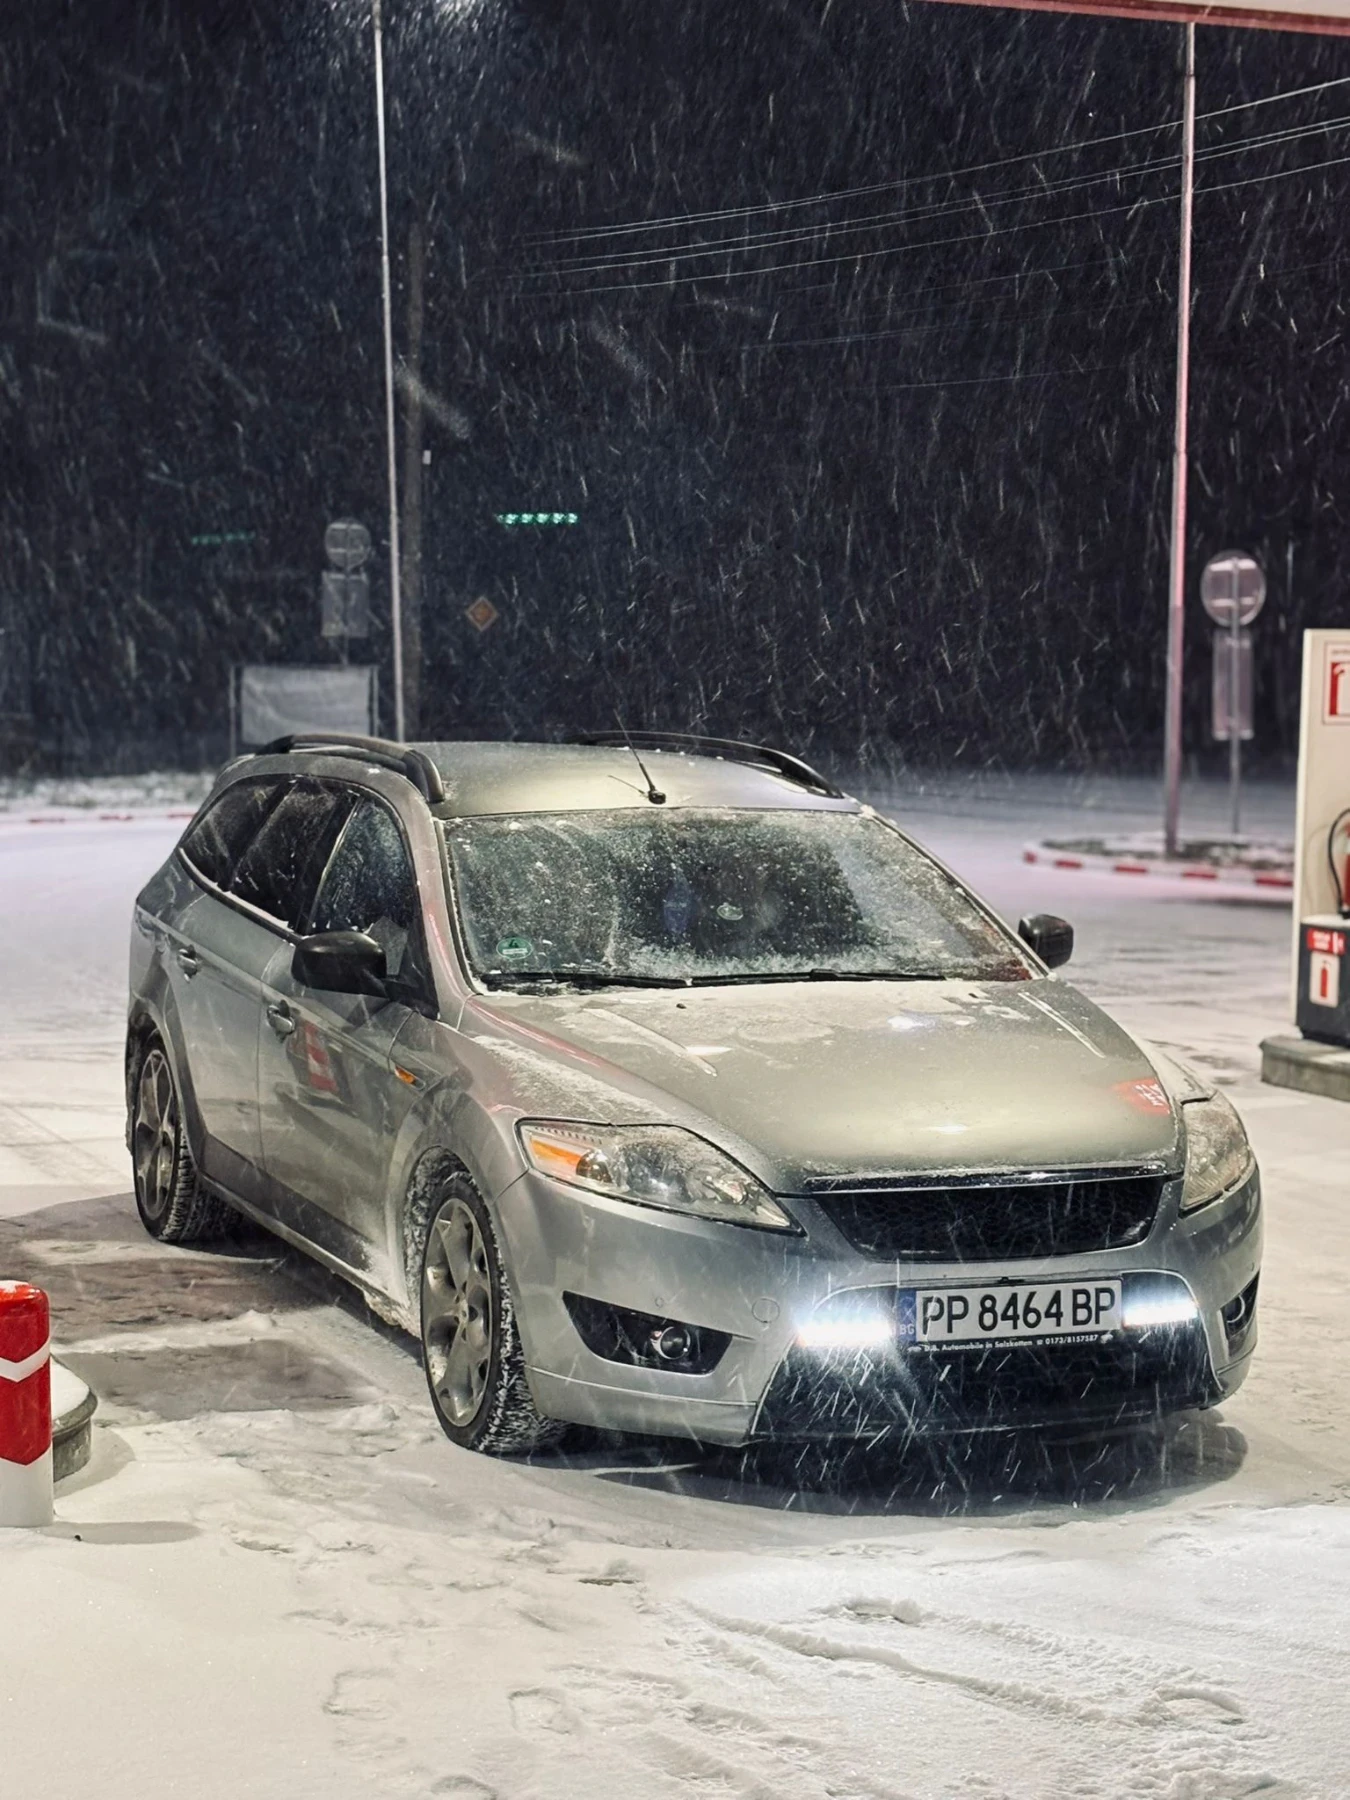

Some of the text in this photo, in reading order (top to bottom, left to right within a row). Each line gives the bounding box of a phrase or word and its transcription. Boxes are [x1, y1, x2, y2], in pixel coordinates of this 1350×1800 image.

[922, 1287, 1115, 1335] PP 8464 BP
[899, 1323, 915, 1335] BG
[985, 1341, 993, 1349] in
